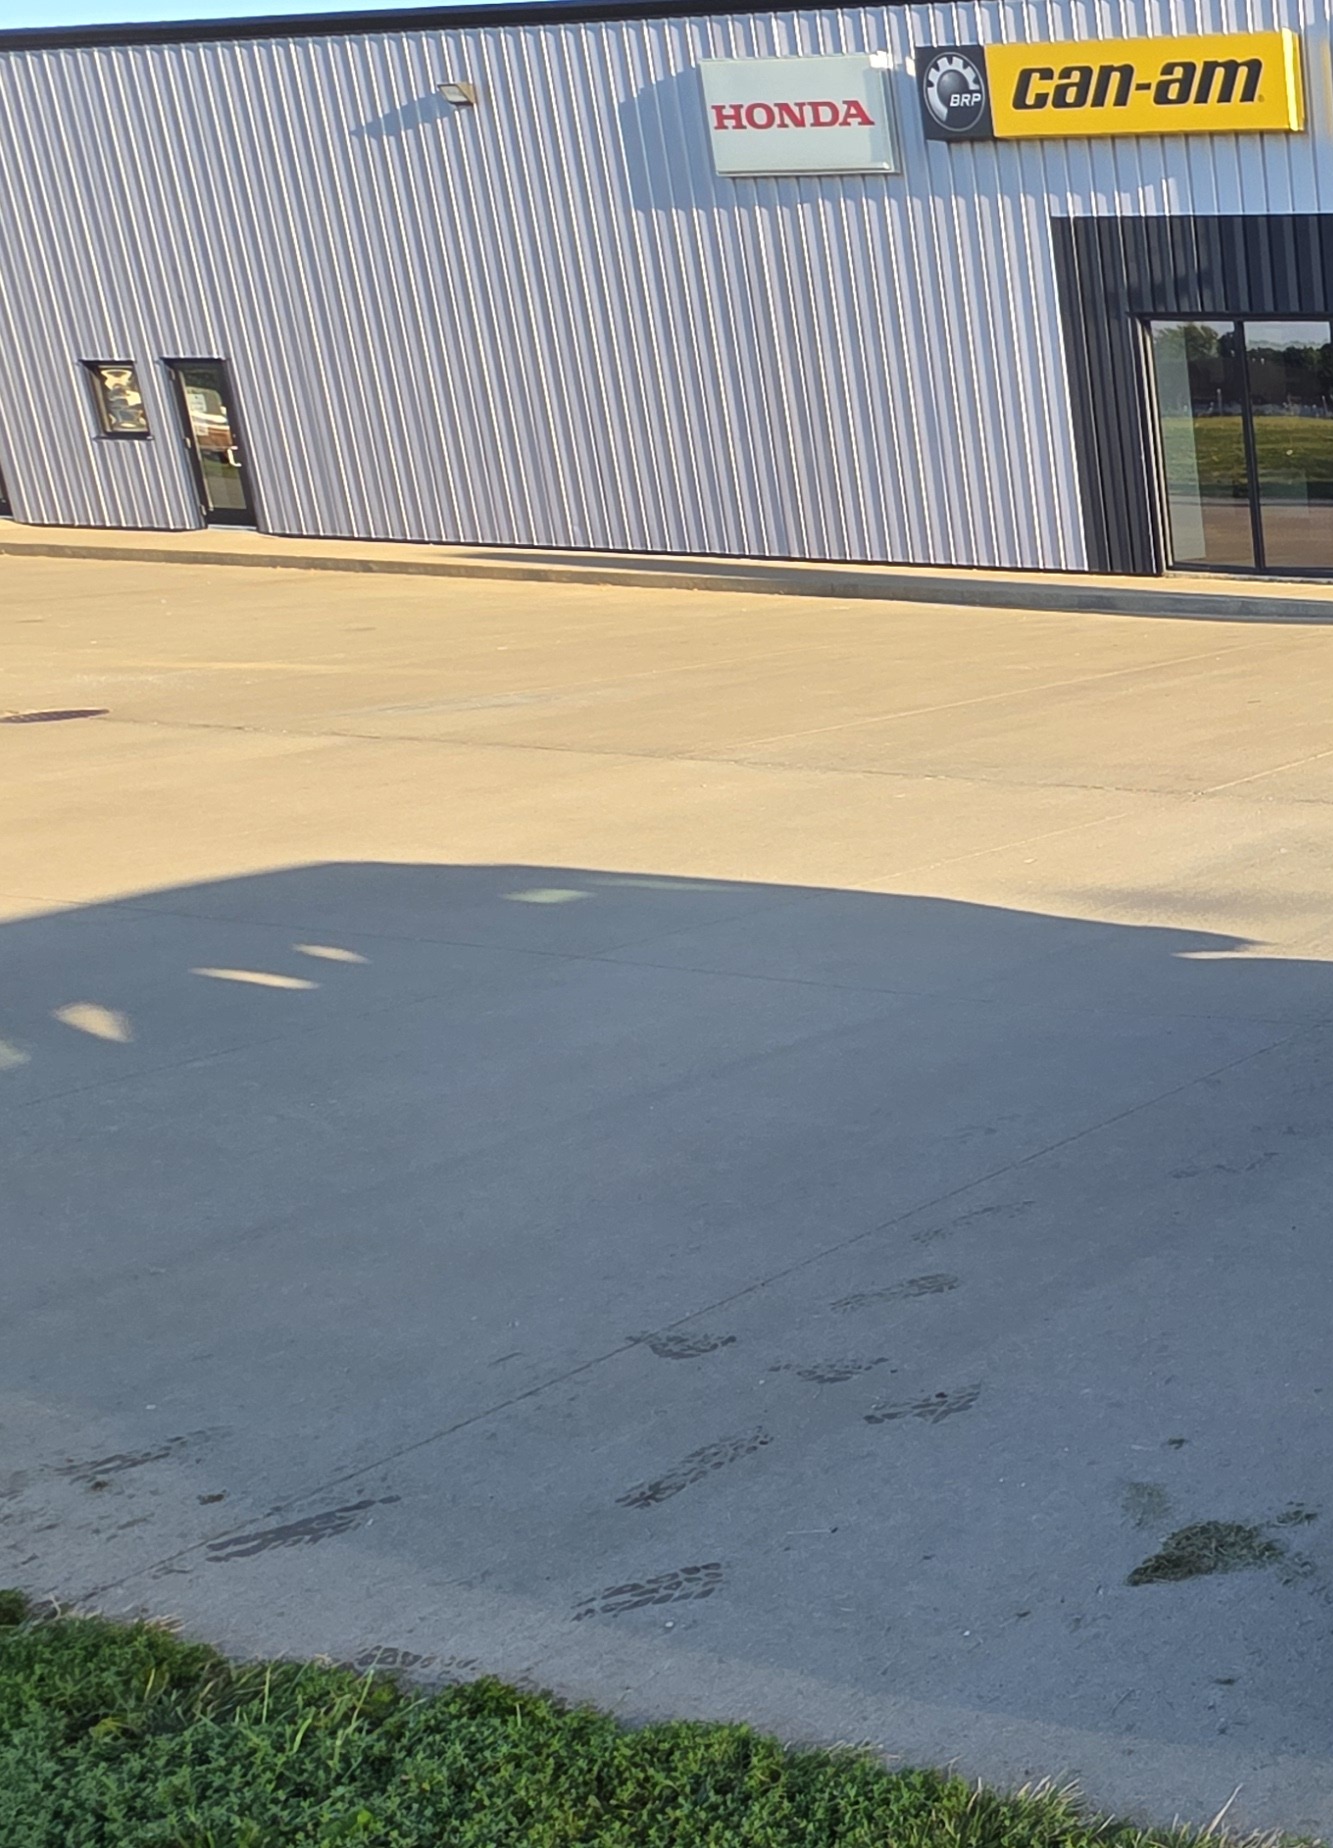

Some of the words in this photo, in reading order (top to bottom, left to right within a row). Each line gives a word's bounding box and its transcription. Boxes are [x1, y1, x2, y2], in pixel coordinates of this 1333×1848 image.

[1012, 57, 1263, 110] can-am
[711, 100, 875, 130] HONDA
[950, 93, 981, 107] BRP
